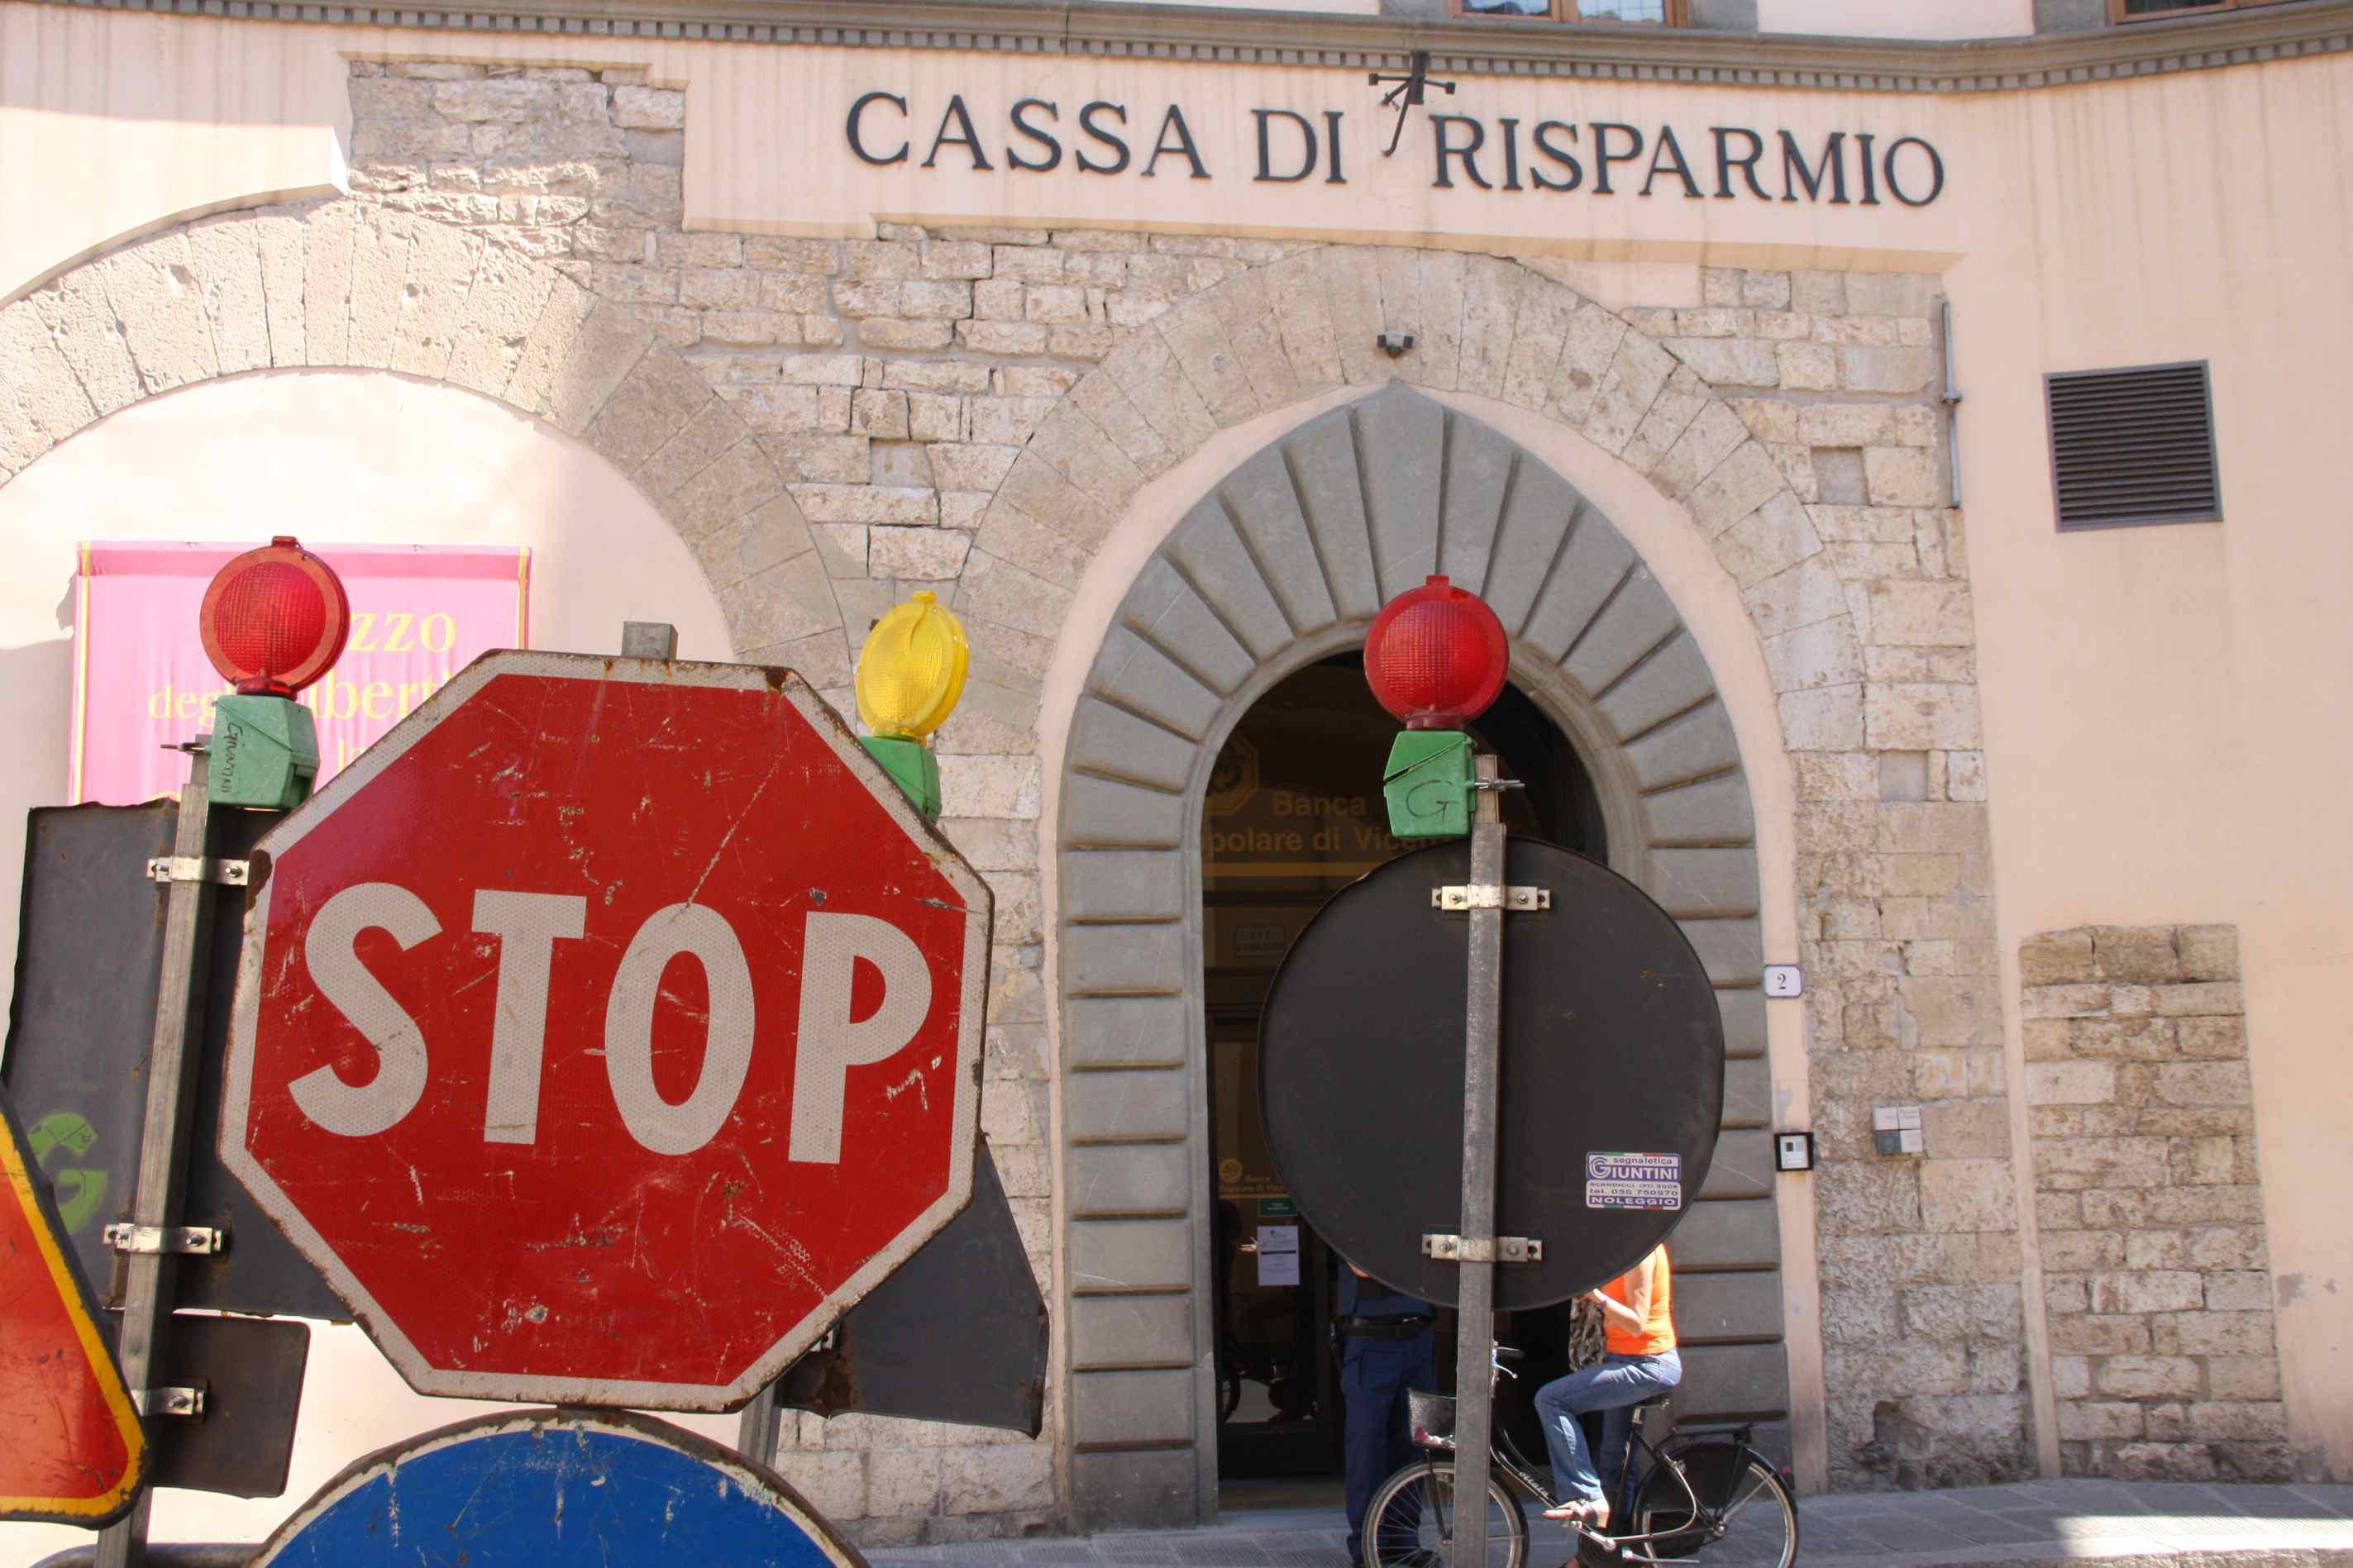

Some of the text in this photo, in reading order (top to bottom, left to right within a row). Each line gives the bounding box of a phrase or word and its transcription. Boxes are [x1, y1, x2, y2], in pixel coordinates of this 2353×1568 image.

[846, 91, 1945, 207] CASSA DI RISPARMIO
[347, 612, 456, 653] zzo
[1272, 790, 1367, 817] Banca
[1202, 826, 1304, 860] polare
[1311, 826, 1341, 851] di
[1777, 973, 1787, 990] 2
[287, 881, 933, 1165] STOP
[1589, 1157, 1678, 1180] GIUNTINI
[1591, 1196, 1675, 1205] NOLEGGIO
